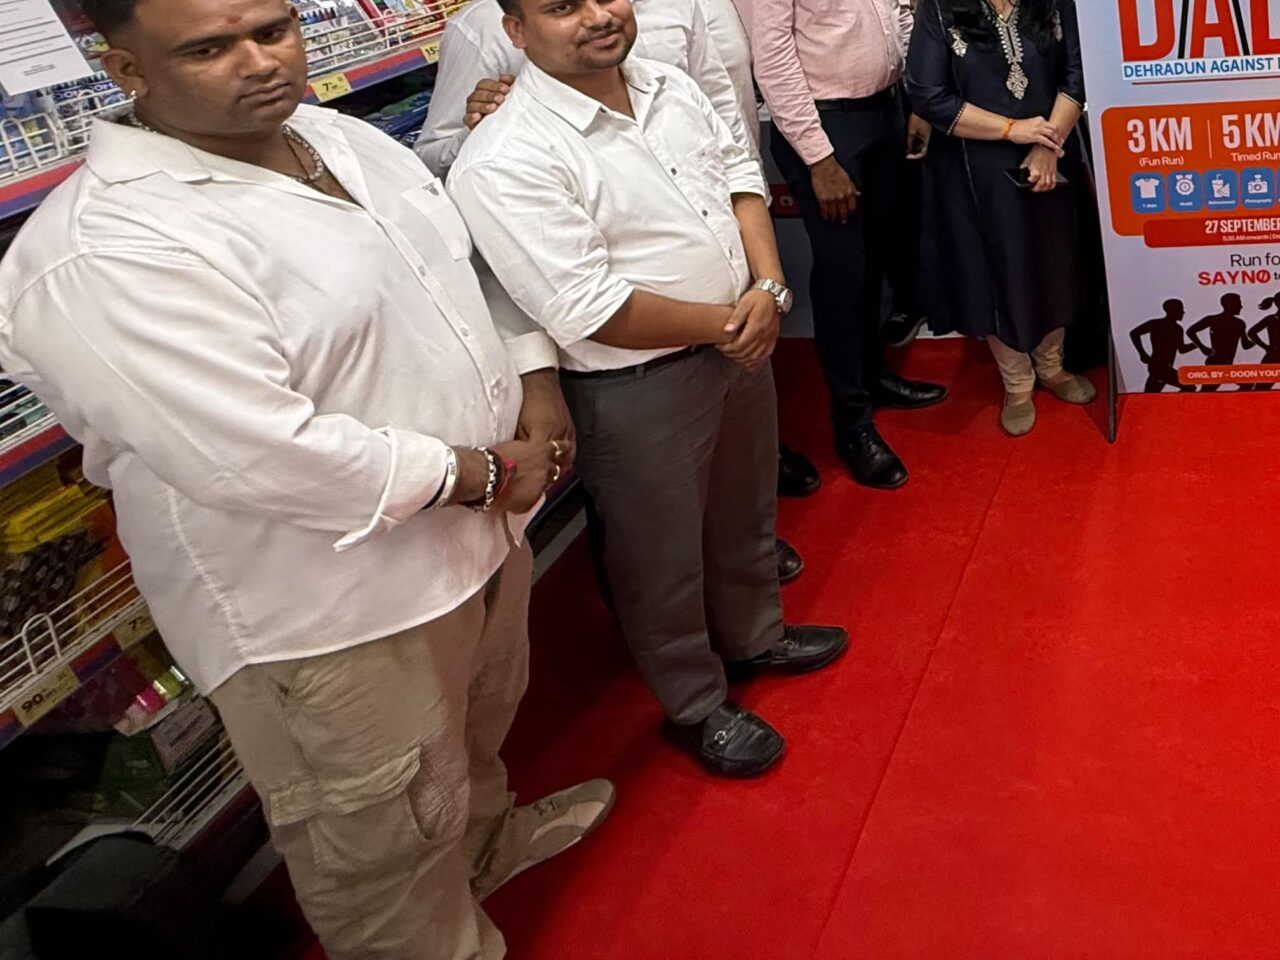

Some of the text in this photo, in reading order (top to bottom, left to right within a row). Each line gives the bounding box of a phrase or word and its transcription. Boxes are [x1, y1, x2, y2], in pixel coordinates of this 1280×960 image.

[1124, 62, 1208, 78] DEHRADUN
[1210, 58, 1273, 74] AGAINST
[1126, 116, 1193, 153] 3 KM
[1221, 114, 1241, 149] 5
[1139, 156, 1184, 168] (Fun Run)
[1231, 152, 1261, 162] Timed
[1205, 221, 1219, 234] 27
[1230, 254, 1262, 267] Run
[1187, 371, 1210, 379] ORG.
[1230, 369, 1258, 378] DOON
